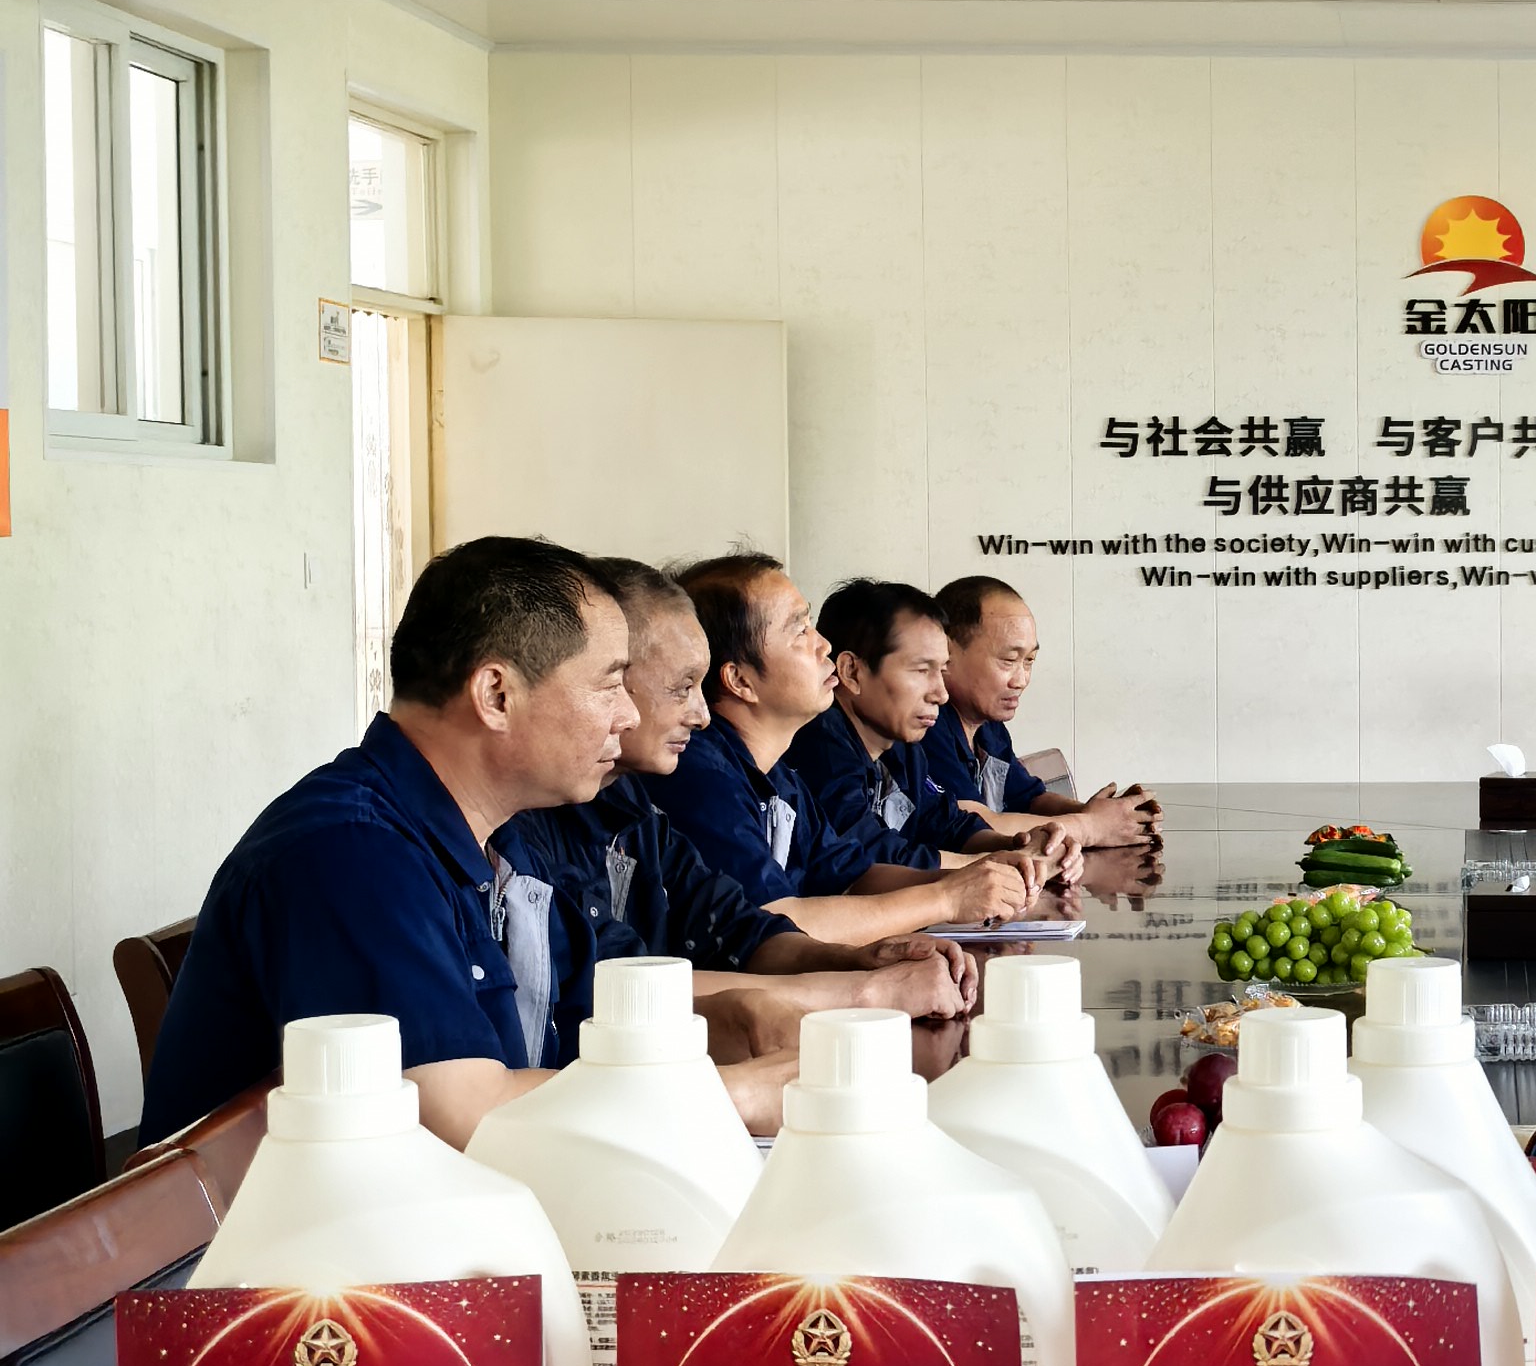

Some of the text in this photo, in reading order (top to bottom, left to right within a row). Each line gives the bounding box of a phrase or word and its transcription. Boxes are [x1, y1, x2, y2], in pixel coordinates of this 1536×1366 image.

[1425, 344, 1527, 355] GOLDENSUN
[1437, 358, 1512, 370] CASTING
[1100, 416, 1325, 457] 与社会共赢
[1204, 475, 1470, 516] 与供应商共赢
[978, 535, 1093, 555] Win-win
[1101, 534, 1157, 555] with
[1165, 534, 1205, 553] the
[1444, 533, 1495, 553] with
[1263, 566, 1316, 586] with
